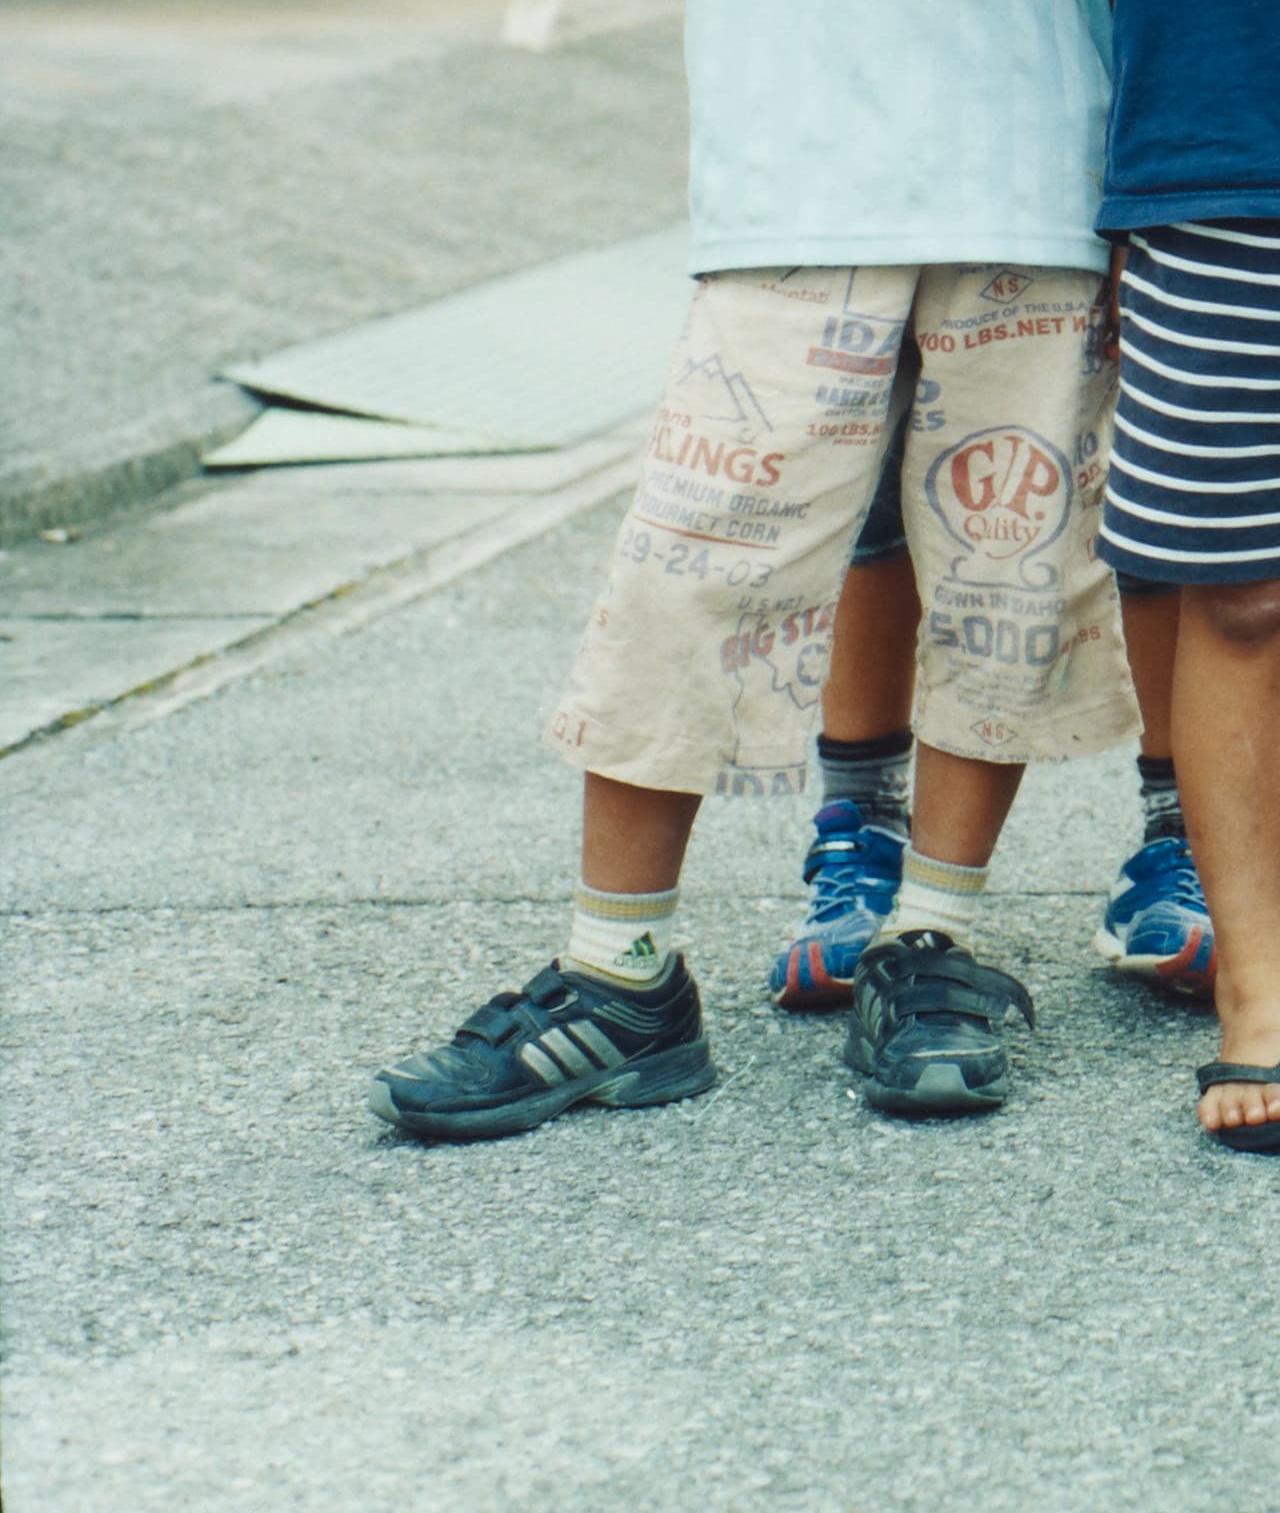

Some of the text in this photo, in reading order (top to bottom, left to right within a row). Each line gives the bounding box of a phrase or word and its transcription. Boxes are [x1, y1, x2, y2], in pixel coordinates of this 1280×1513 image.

[1002, 305, 1019, 318] OF
[1024, 303, 1049, 314] THE
[649, 424, 785, 487] LINGS
[728, 493, 811, 520] ORGANIC
[725, 519, 783, 543] CORN
[720, 621, 776, 674] BIG
